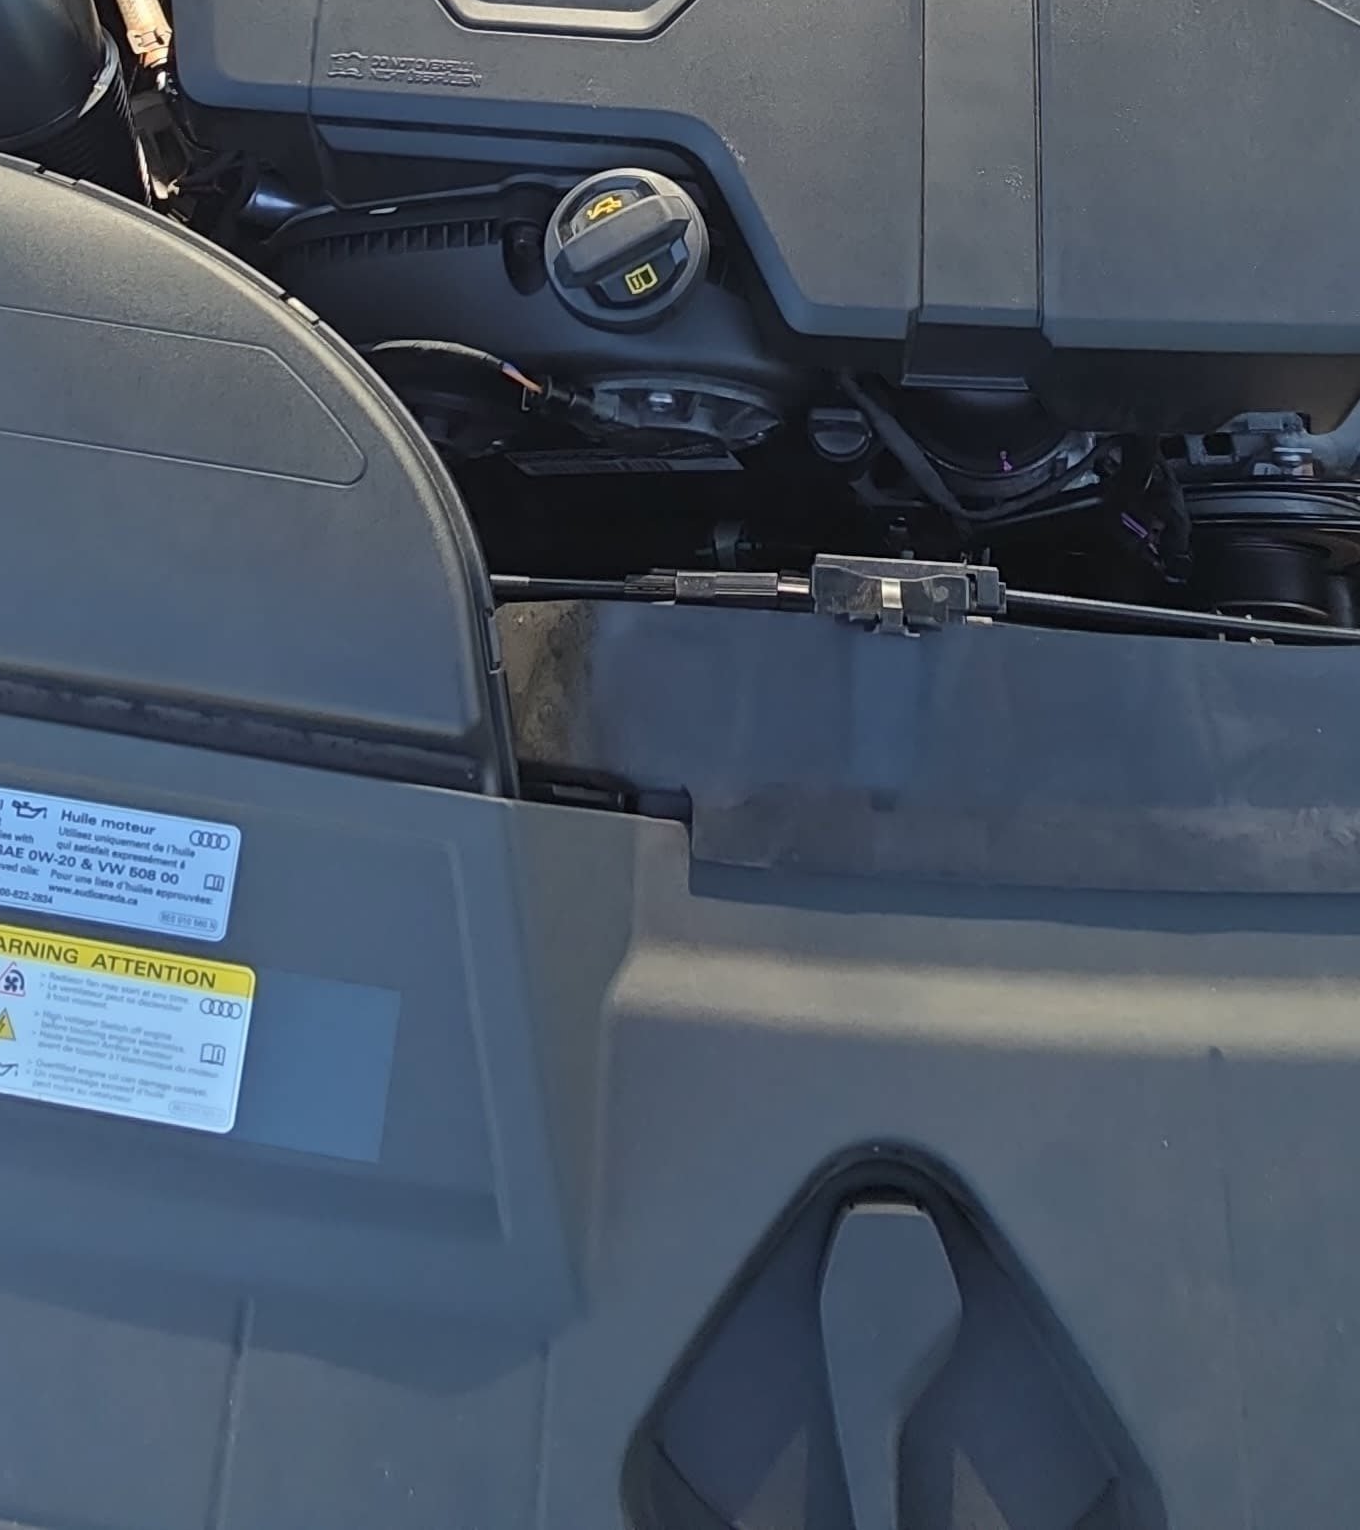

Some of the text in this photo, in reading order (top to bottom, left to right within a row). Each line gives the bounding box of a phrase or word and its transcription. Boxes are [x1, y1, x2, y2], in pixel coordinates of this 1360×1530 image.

[60, 809, 156, 835] Huile moteur
[14, 832, 34, 843] with
[57, 826, 92, 840] Utilisez
[94, 833, 149, 850] uniquement
[152, 843, 164, 852] de
[27, 849, 76, 867] 0W-20
[80, 857, 92, 870] &
[97, 860, 125, 875] VW
[128, 866, 156, 881] 508
[160, 871, 179, 884] 00
[55, 841, 71, 851] qui
[74, 843, 109, 856] satisfait
[111, 849, 177, 868] expressément
[49, 869, 73, 881] Pour
[75, 874, 92, 884] une
[94, 876, 113, 887] liste
[47, 883, 137, 906] www.audicanada.ca
[90, 952, 216, 988] ATTENTION
[49, 971, 83, 984] Radiator
[85, 978, 99, 987] fan
[101, 981, 118, 992] may
[121, 984, 140, 994] start
[152, 991, 166, 1001] any
